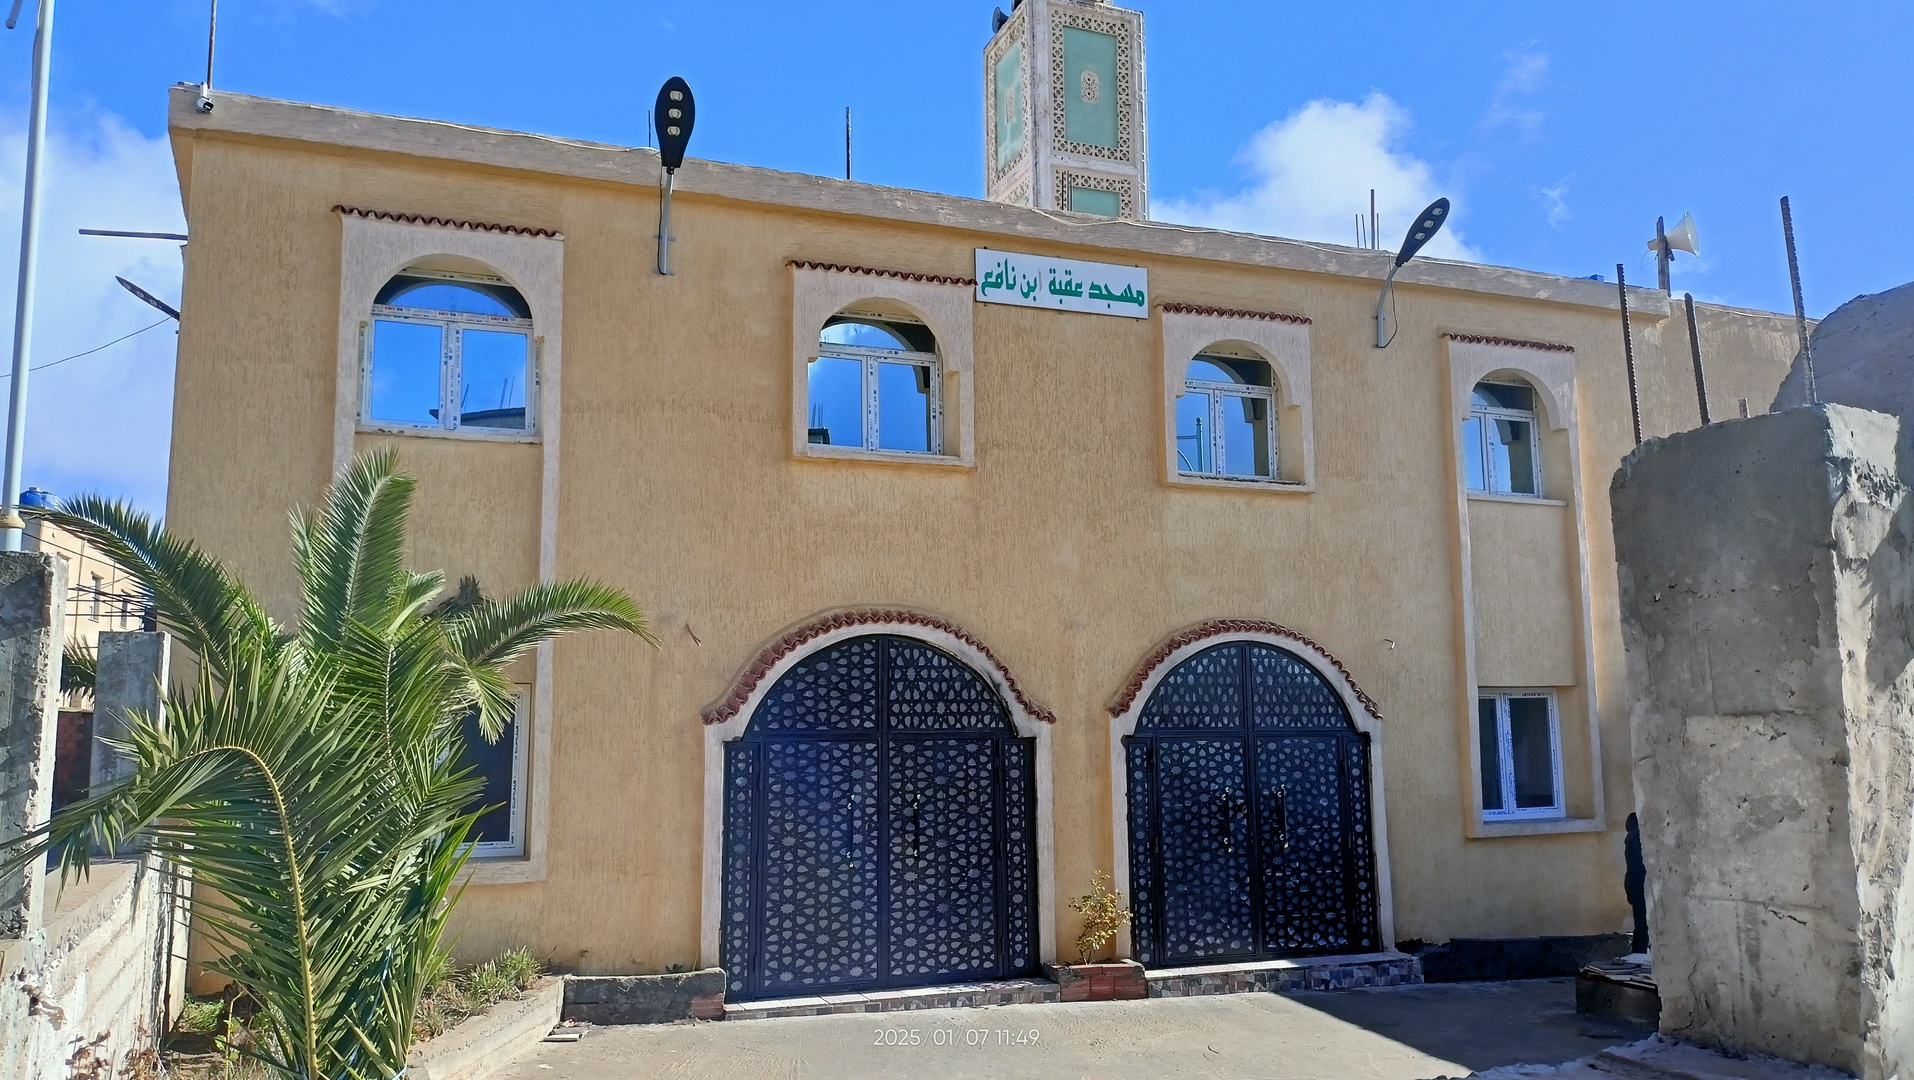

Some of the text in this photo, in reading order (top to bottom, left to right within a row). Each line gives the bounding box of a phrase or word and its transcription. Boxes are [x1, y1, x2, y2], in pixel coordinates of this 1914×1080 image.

[980, 257, 1145, 309] مسجد عقبة ابن نافع
